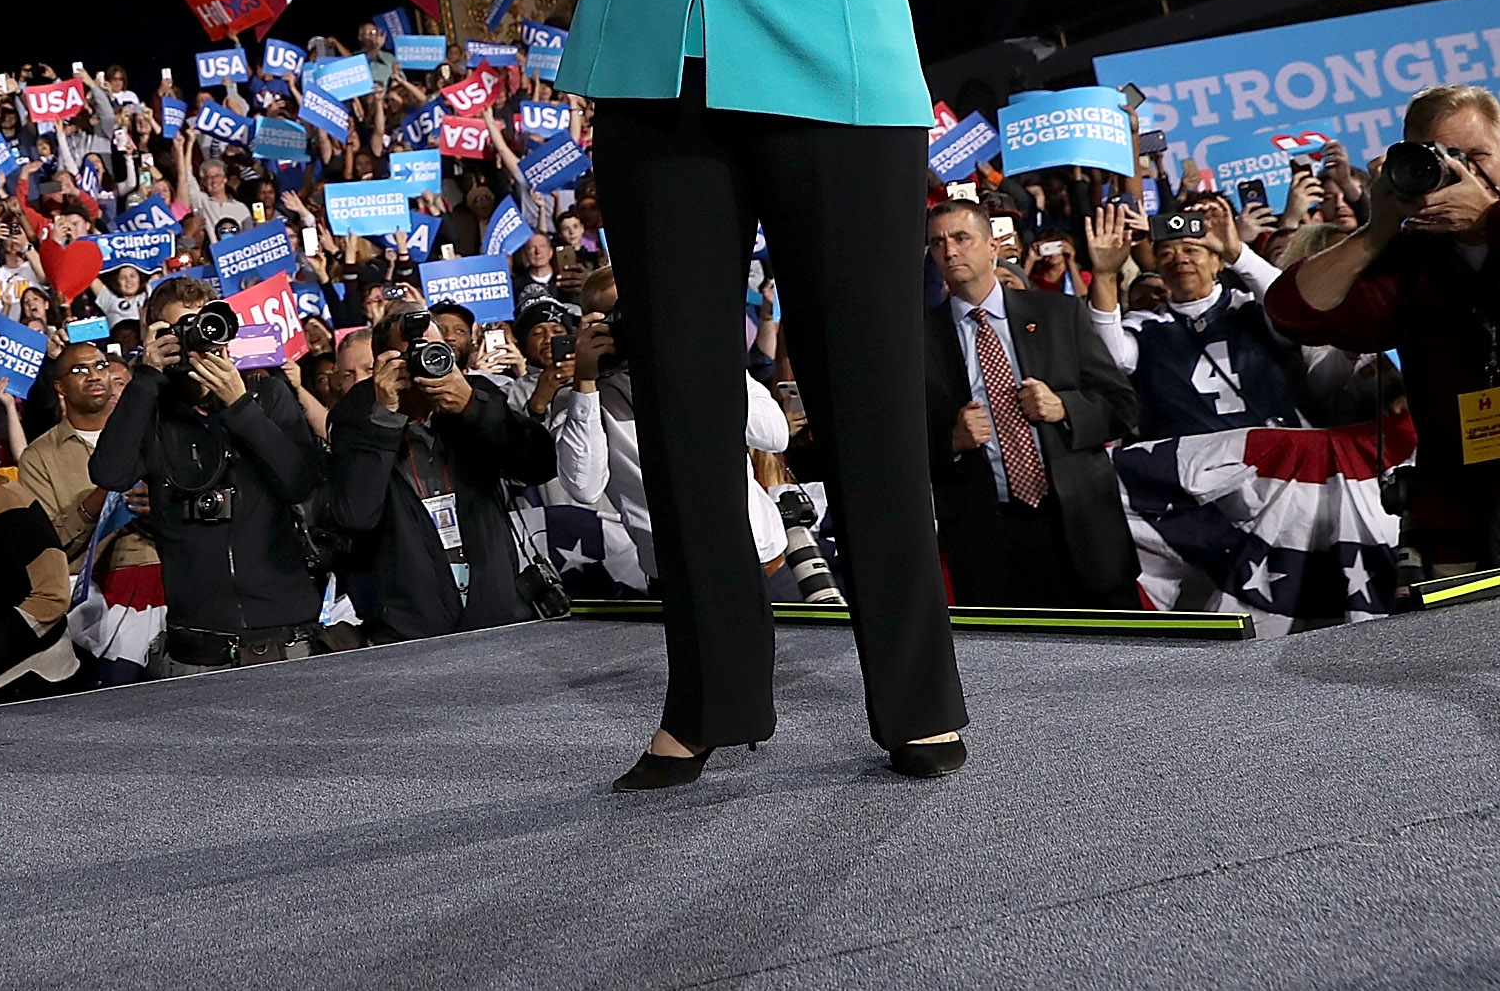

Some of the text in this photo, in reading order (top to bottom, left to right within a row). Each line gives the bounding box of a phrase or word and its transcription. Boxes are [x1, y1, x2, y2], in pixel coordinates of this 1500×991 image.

[523, 25, 562, 48] USA
[199, 55, 247, 78] USA
[29, 86, 84, 115] USA
[447, 71, 499, 110] USA
[198, 107, 249, 145] USA
[406, 106, 446, 143] USA
[523, 107, 570, 129] USA
[1006, 106, 1125, 136] STRONGER
[930, 122, 990, 167] STRONGER
[936, 129, 996, 174] TOGETHER
[1007, 123, 1128, 151] TOGETHER
[525, 141, 577, 178] STRONGER
[331, 193, 404, 208] STRONGER
[331, 204, 405, 220] TOGETHER
[111, 233, 170, 252] Clinton
[217, 234, 287, 267] STRONGER
[220, 245, 290, 279] TOGETHER
[427, 271, 508, 290] STRONGER
[429, 286, 510, 305] TOGETHER
[1190, 340, 1247, 415] 4
